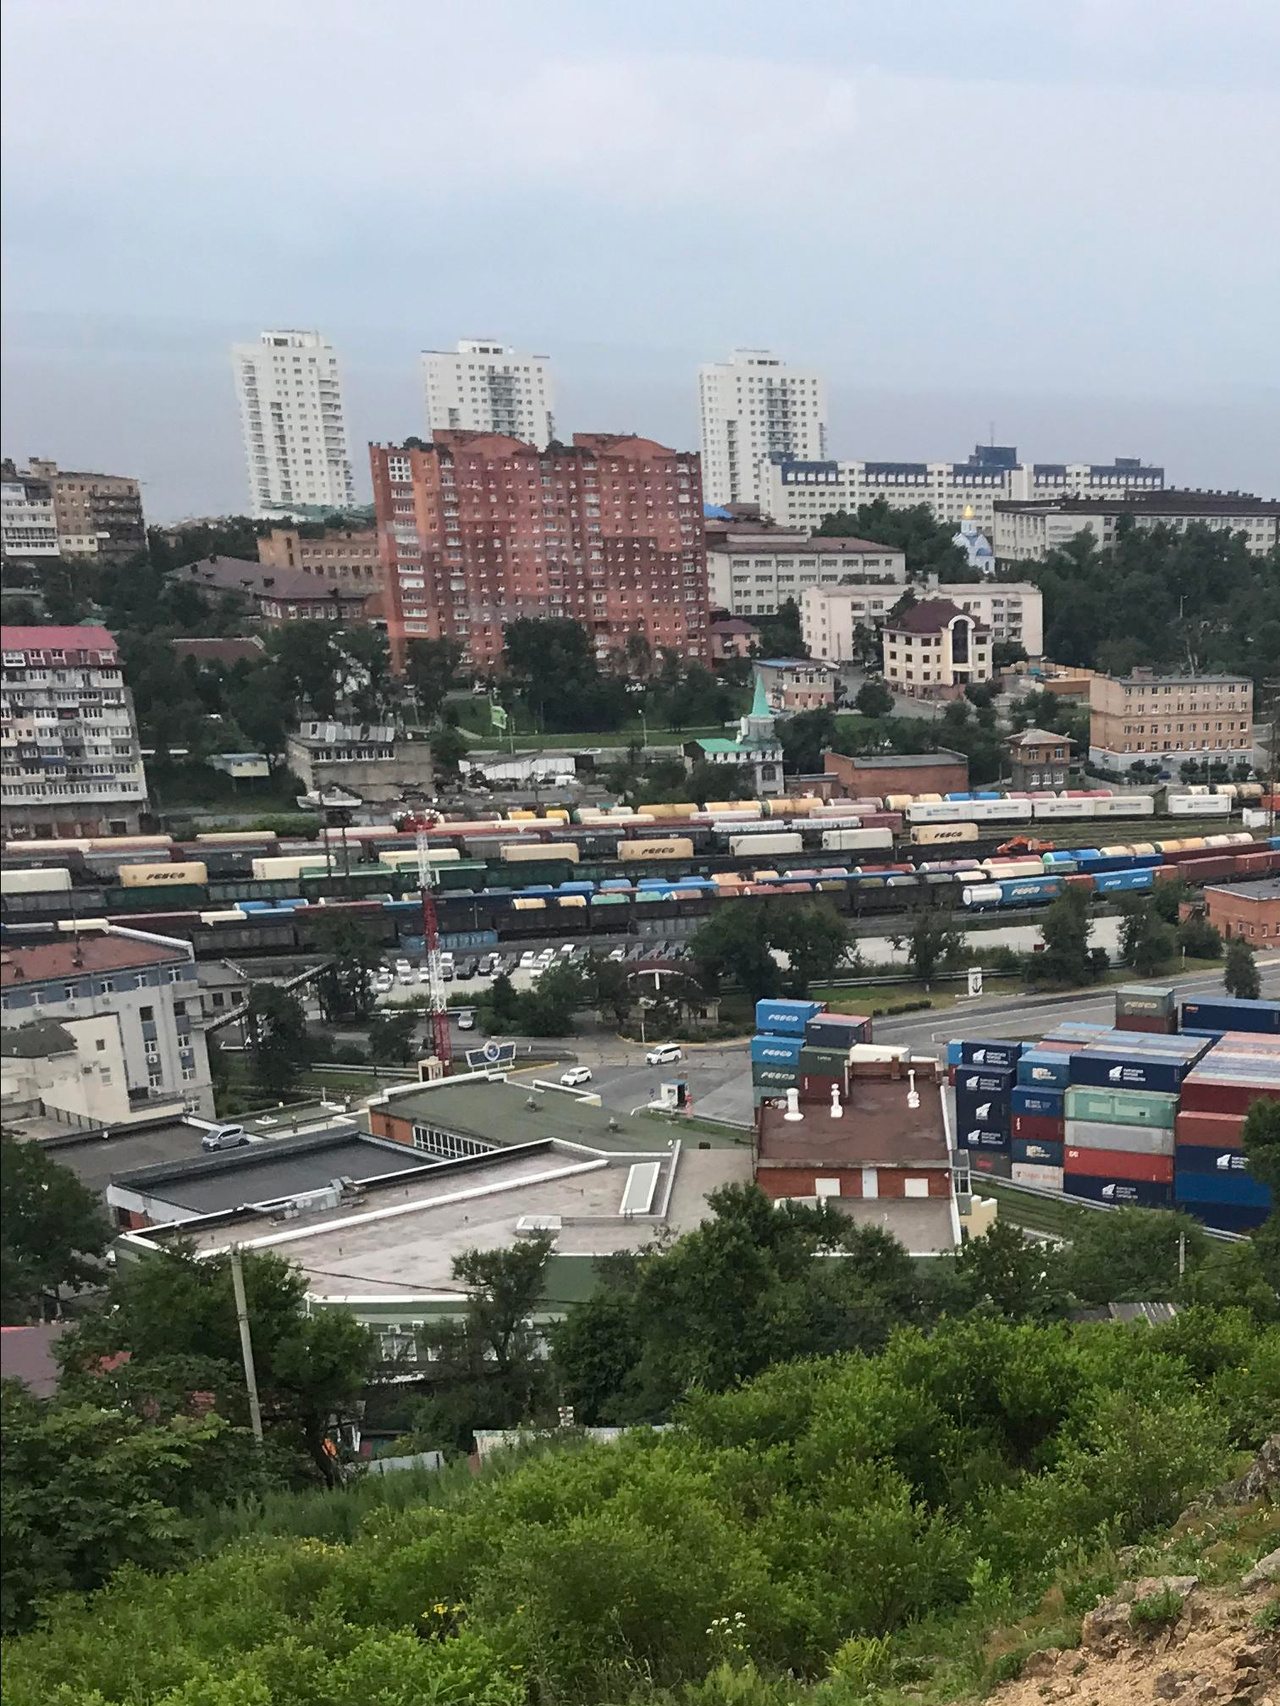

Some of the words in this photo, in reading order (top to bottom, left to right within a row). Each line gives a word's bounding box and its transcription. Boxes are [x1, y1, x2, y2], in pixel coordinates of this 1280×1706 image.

[934, 831, 963, 839] FESCO
[642, 847, 676, 856] FESCO
[146, 871, 186, 881] FESCO
[1011, 886, 1041, 896] FESCO
[768, 1014, 799, 1022] FESCO
[762, 1048, 793, 1057] FESCO
[761, 1071, 796, 1080] FESCO
